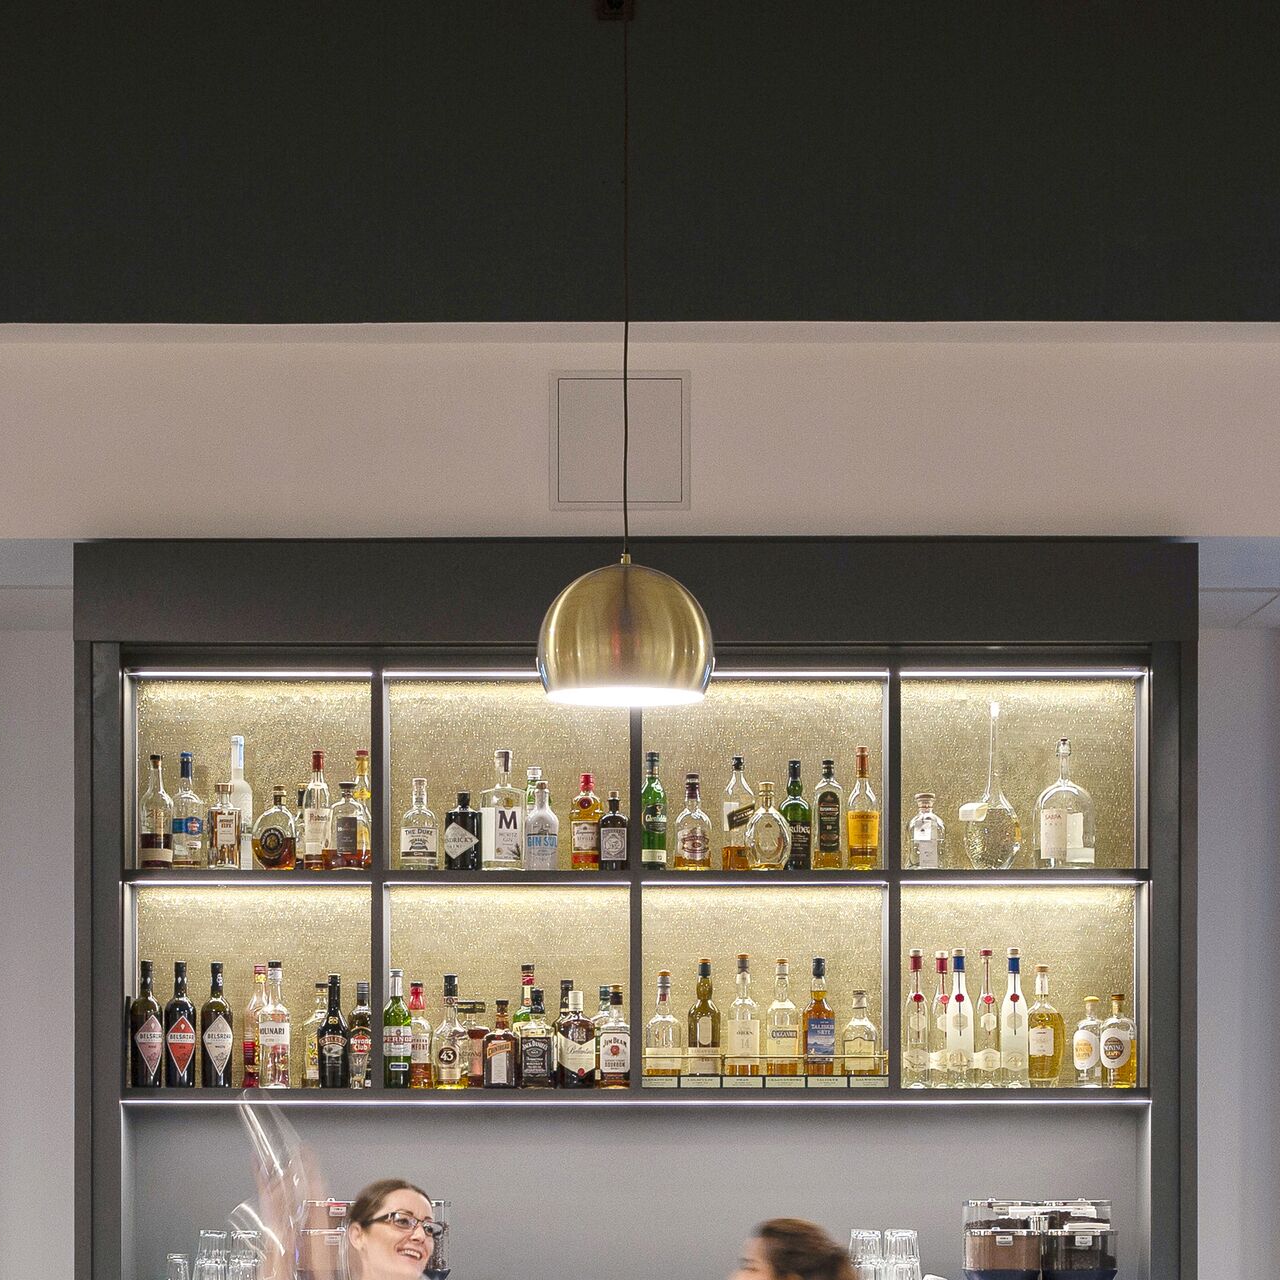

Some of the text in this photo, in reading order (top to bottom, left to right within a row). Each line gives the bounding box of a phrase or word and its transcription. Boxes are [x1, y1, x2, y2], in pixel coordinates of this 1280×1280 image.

[498, 810, 518, 830] M
[527, 836, 542, 848] GIN
[603, 1036, 627, 1048] JIM BEAM
[440, 1050, 454, 1061] 43
